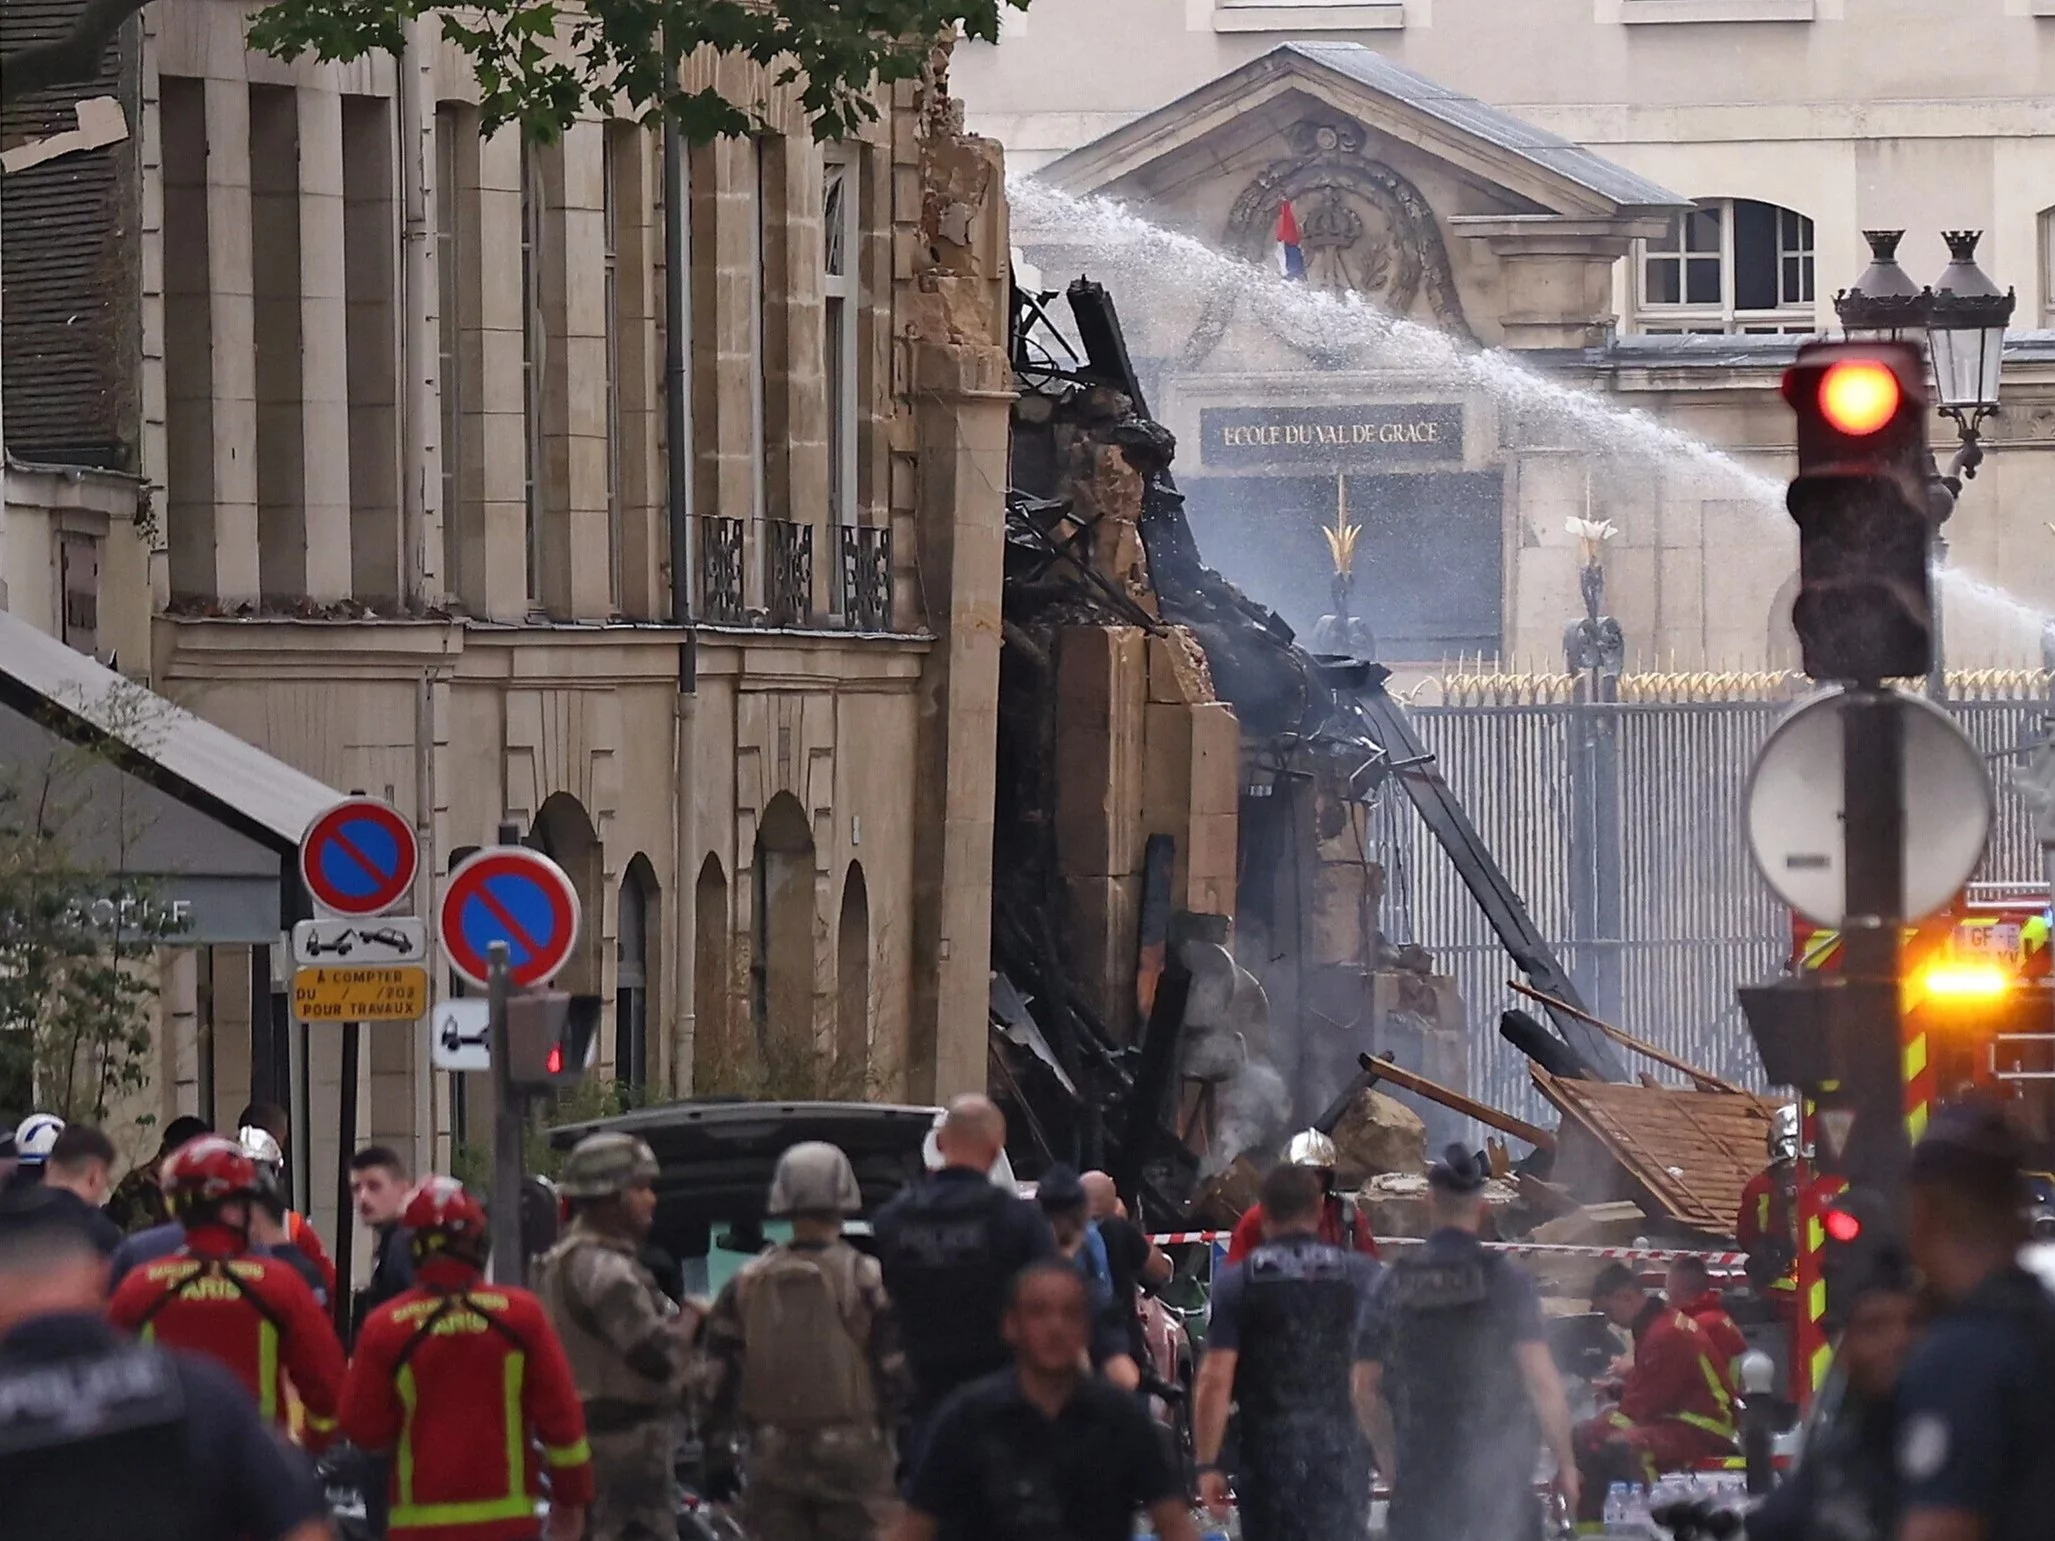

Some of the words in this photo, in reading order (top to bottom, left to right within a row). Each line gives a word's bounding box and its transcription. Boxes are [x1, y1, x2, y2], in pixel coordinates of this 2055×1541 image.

[1223, 427, 1280, 446] ECOLE
[1285, 424, 1312, 444] DU
[1316, 423, 1349, 444] VAL
[1352, 424, 1375, 443] DE
[333, 972, 402, 983] COMPTER
[296, 988, 316, 1000] DU
[303, 1004, 342, 1017] POUR
[352, 1003, 413, 1015] TRAVAUX
